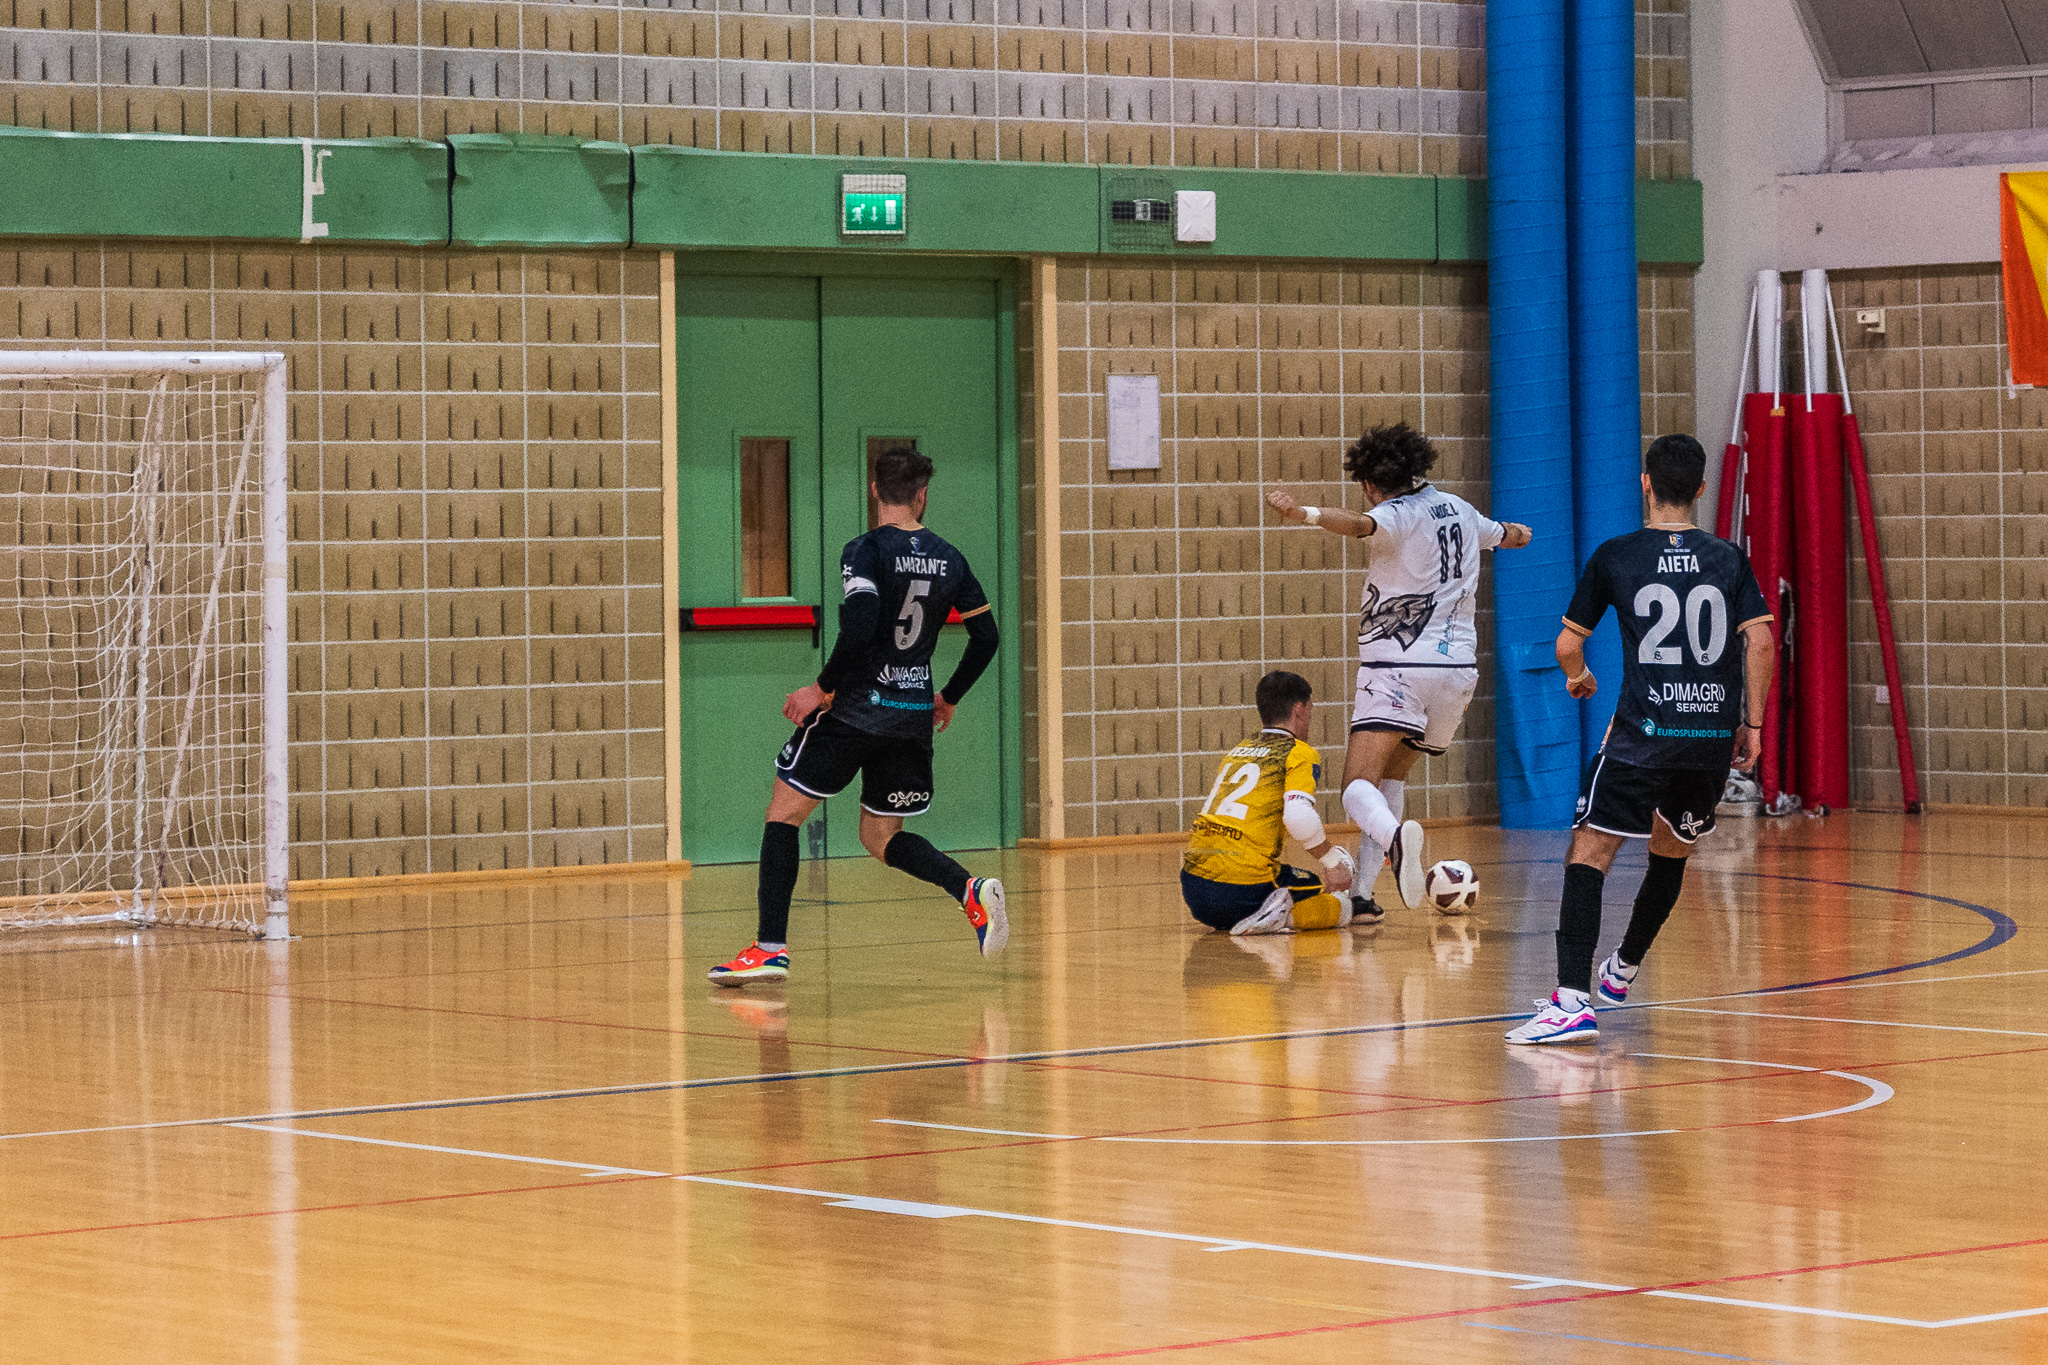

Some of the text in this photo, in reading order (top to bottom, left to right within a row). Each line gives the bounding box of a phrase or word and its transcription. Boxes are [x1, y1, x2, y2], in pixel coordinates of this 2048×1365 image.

[1437, 522, 1463, 584] 11
[1657, 555, 1700, 573] AIETA
[894, 579, 931, 650] 5
[1633, 583, 1728, 666] 20
[1656, 727, 1718, 738] EUROSPLENDOR
[1676, 702, 1720, 713] SERVICE
[1200, 762, 1261, 820] 12
